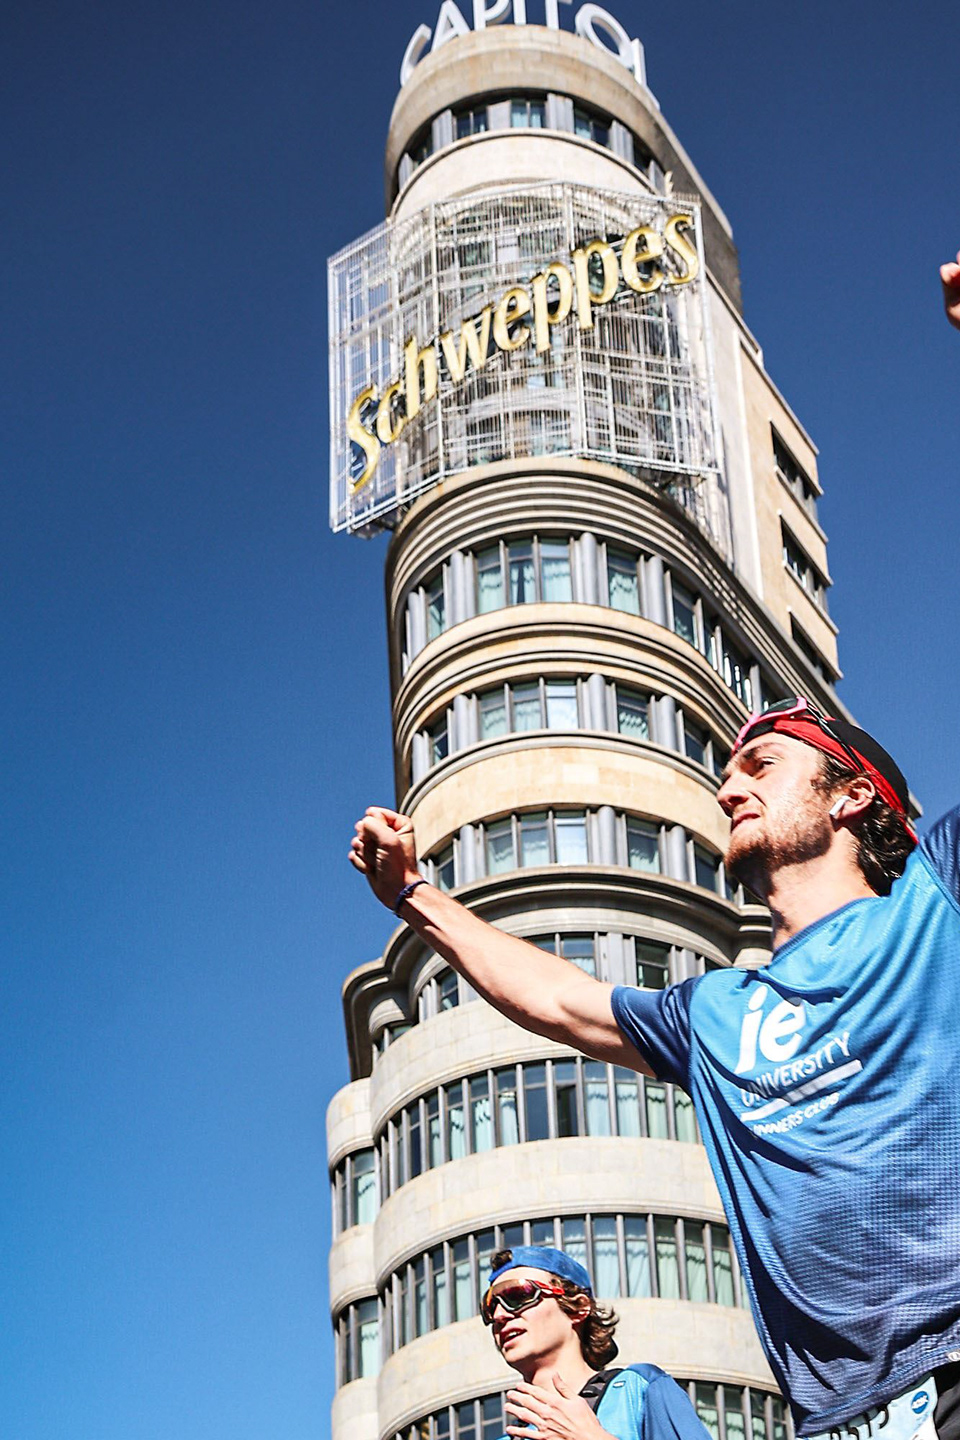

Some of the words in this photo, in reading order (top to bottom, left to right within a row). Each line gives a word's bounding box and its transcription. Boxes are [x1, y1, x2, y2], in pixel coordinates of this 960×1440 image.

[348, 213, 700, 492] Schweppes
[735, 985, 807, 1074] ie
[740, 1031, 850, 1107] UNIVERSITY
